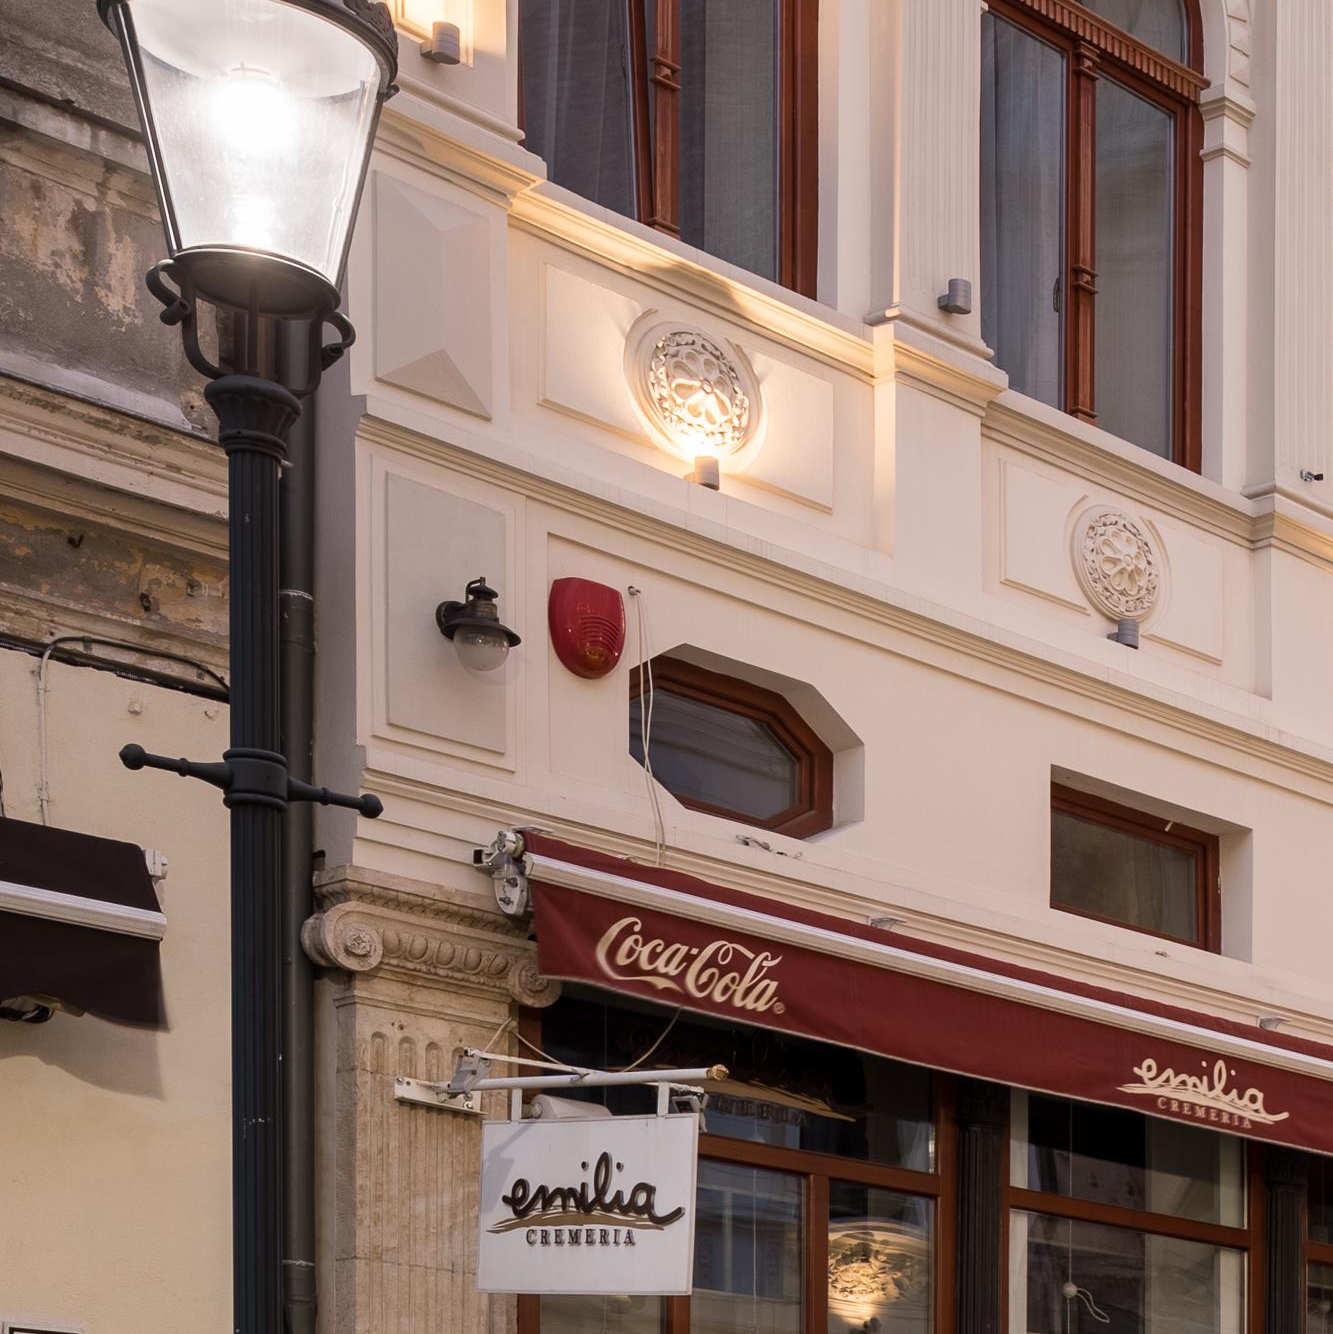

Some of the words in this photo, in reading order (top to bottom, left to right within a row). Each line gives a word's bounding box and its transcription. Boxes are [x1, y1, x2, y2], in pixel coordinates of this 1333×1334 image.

[596, 917, 783, 1012] Coca-Cola
[1133, 1058, 1290, 1122] emilia
[1157, 1097, 1252, 1128] CREMERIA
[502, 1152, 685, 1225] emilia
[526, 1228, 637, 1246] CREMERIA
